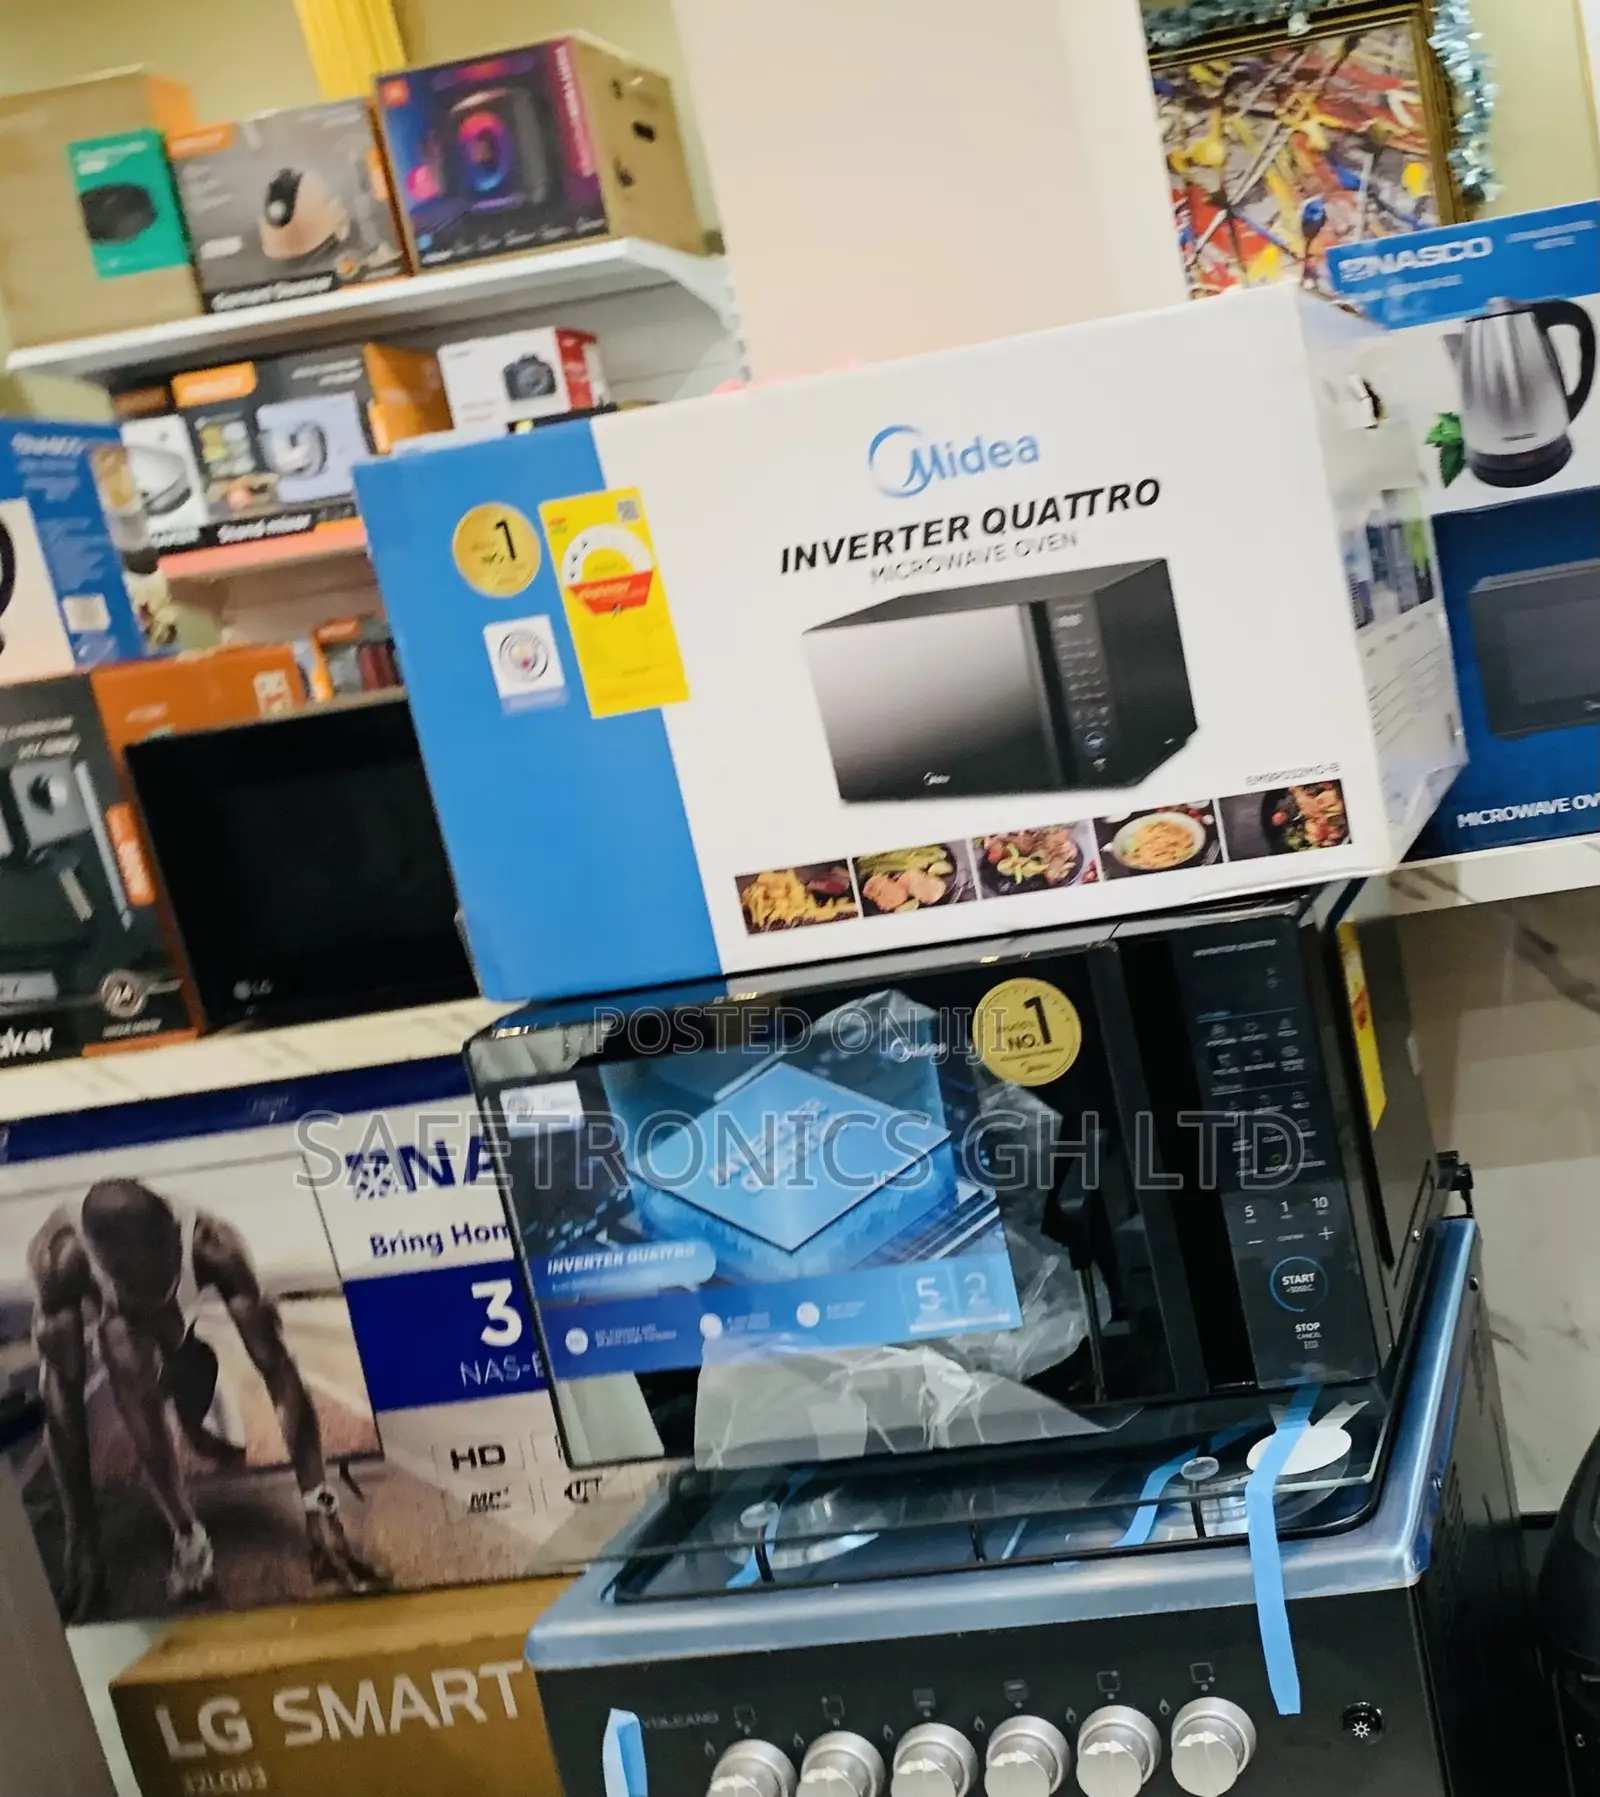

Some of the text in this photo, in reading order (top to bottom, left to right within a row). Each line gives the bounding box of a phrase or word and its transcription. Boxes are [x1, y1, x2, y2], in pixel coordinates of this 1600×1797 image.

[1376, 236, 1494, 276] NASCO
[868, 425, 1040, 499] Midea
[494, 520, 516, 561] 1
[780, 478, 1161, 576] INVERTER QUATTRO
[871, 530, 1078, 587] MICROWAVE OVEN
[1456, 797, 1571, 829] MICROWAVE
[1023, 995, 1053, 1046] 1
[1007, 1033, 1041, 1051] NO.
[1244, 1196, 1330, 1218] 5 1 10
[369, 1230, 445, 1257] Bring
[547, 1252, 625, 1277] INVERTER
[1281, 1272, 1316, 1286] START
[916, 1276, 941, 1312] 5
[471, 1278, 523, 1348] 3
[1294, 1321, 1321, 1333] STOP
[449, 1443, 506, 1472] HD
[155, 1660, 525, 1760] LG SMART
